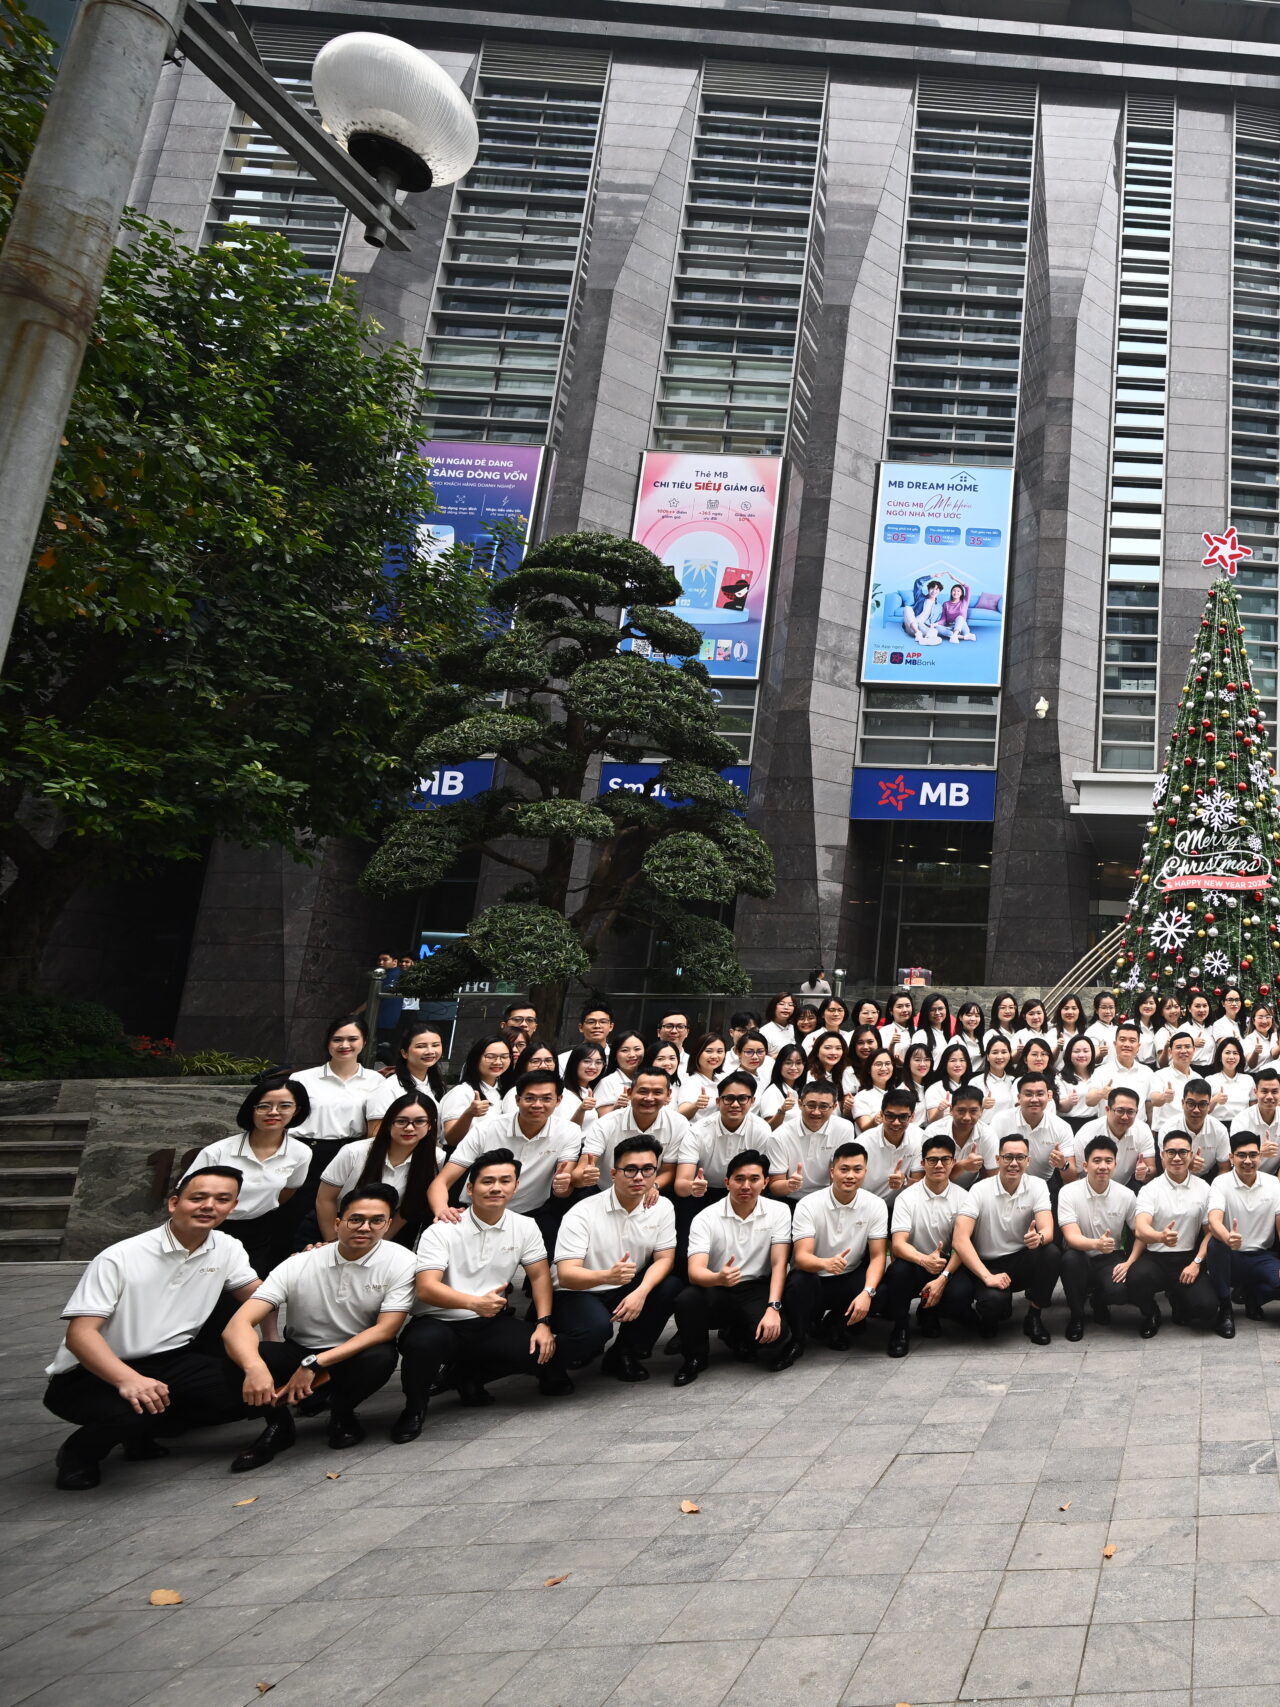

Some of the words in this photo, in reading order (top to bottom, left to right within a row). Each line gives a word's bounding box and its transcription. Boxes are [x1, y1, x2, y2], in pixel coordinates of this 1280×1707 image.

[503, 470, 528, 481] VỐN
[695, 470, 711, 478] Thẻ
[714, 471, 729, 479] MB
[672, 481, 692, 489] TIÊU
[694, 480, 722, 493] SIÊU
[724, 483, 748, 491] GIẢM
[888, 480, 904, 489] MB
[907, 481, 945, 490] DREAM
[947, 483, 979, 492] HOME
[892, 533, 906, 541] 05
[929, 535, 941, 544] 10
[969, 536, 983, 545] 35
[414, 771, 464, 796] MB
[919, 781, 970, 807] MB
[1174, 827, 1240, 851] Merry
[1163, 853, 1261, 879] Christmas
[1174, 879, 1202, 888] HAPPY
[1203, 880, 1223, 888] NEW
[1248, 880, 1267, 888] 2026
